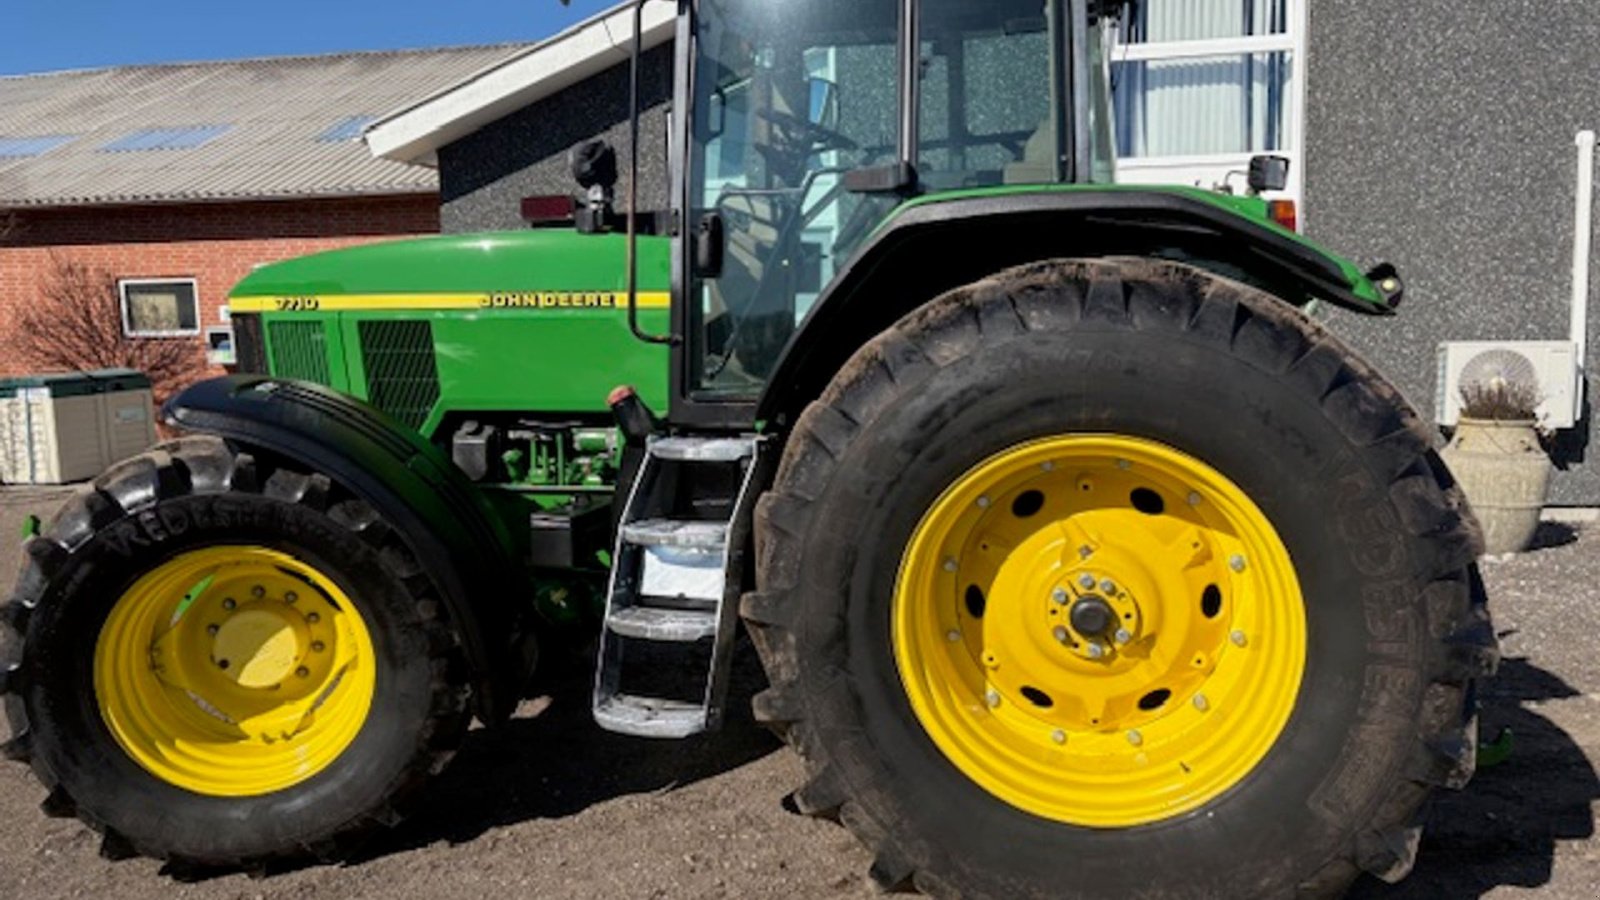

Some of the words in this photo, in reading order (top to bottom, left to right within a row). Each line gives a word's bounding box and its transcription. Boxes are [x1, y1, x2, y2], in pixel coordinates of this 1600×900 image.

[274, 295, 319, 311] 7710
[479, 291, 536, 308] JOHN
[541, 291, 614, 308] DEERE
